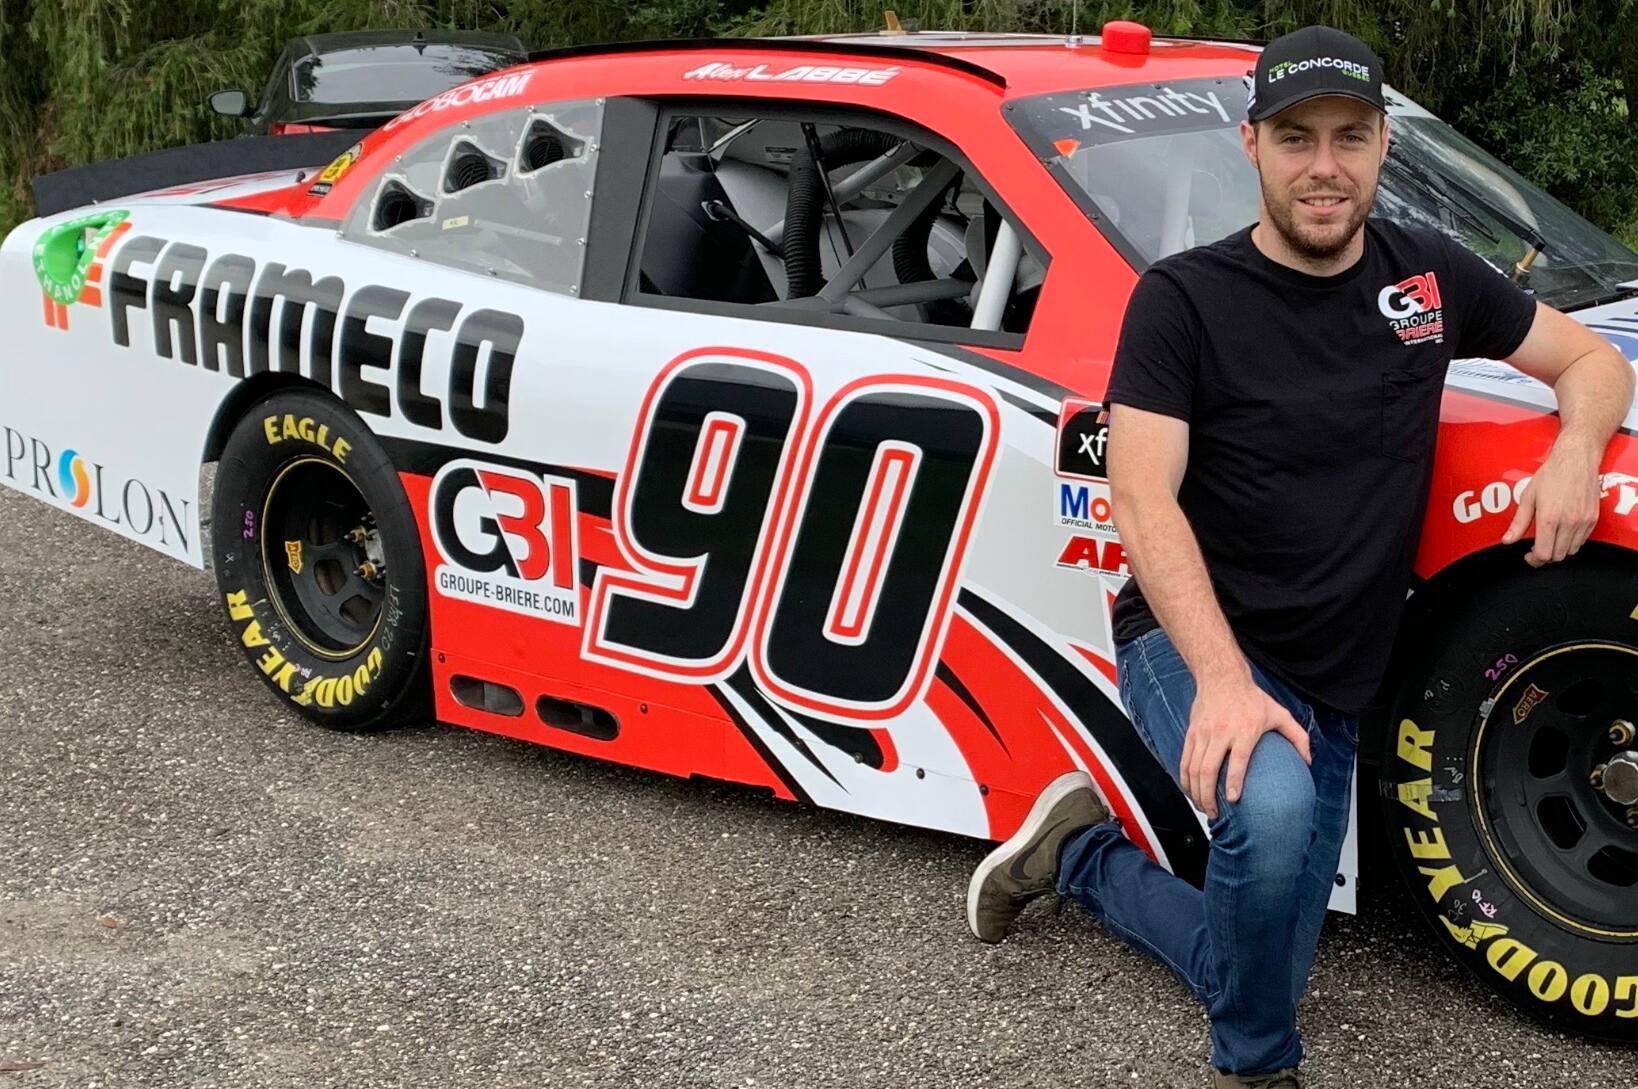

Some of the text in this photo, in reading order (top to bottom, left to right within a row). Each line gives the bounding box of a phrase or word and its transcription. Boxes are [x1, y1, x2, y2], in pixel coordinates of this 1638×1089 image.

[745, 64, 903, 86] LABBÉ
[1268, 57, 1369, 83] LE CONCORDE
[1059, 87, 1231, 134] xfinity
[109, 235, 525, 445] FRAMECO
[1389, 310, 1443, 331] GROUPE
[264, 413, 352, 465] EAGLE
[582, 347, 1000, 721] 90
[1061, 517, 1119, 534] OFFICIAL MOTO
[1058, 535, 1134, 576] AR
[440, 572, 575, 618] GROUPE-BRIERE.COM
[1485, 653, 1518, 680] 250
